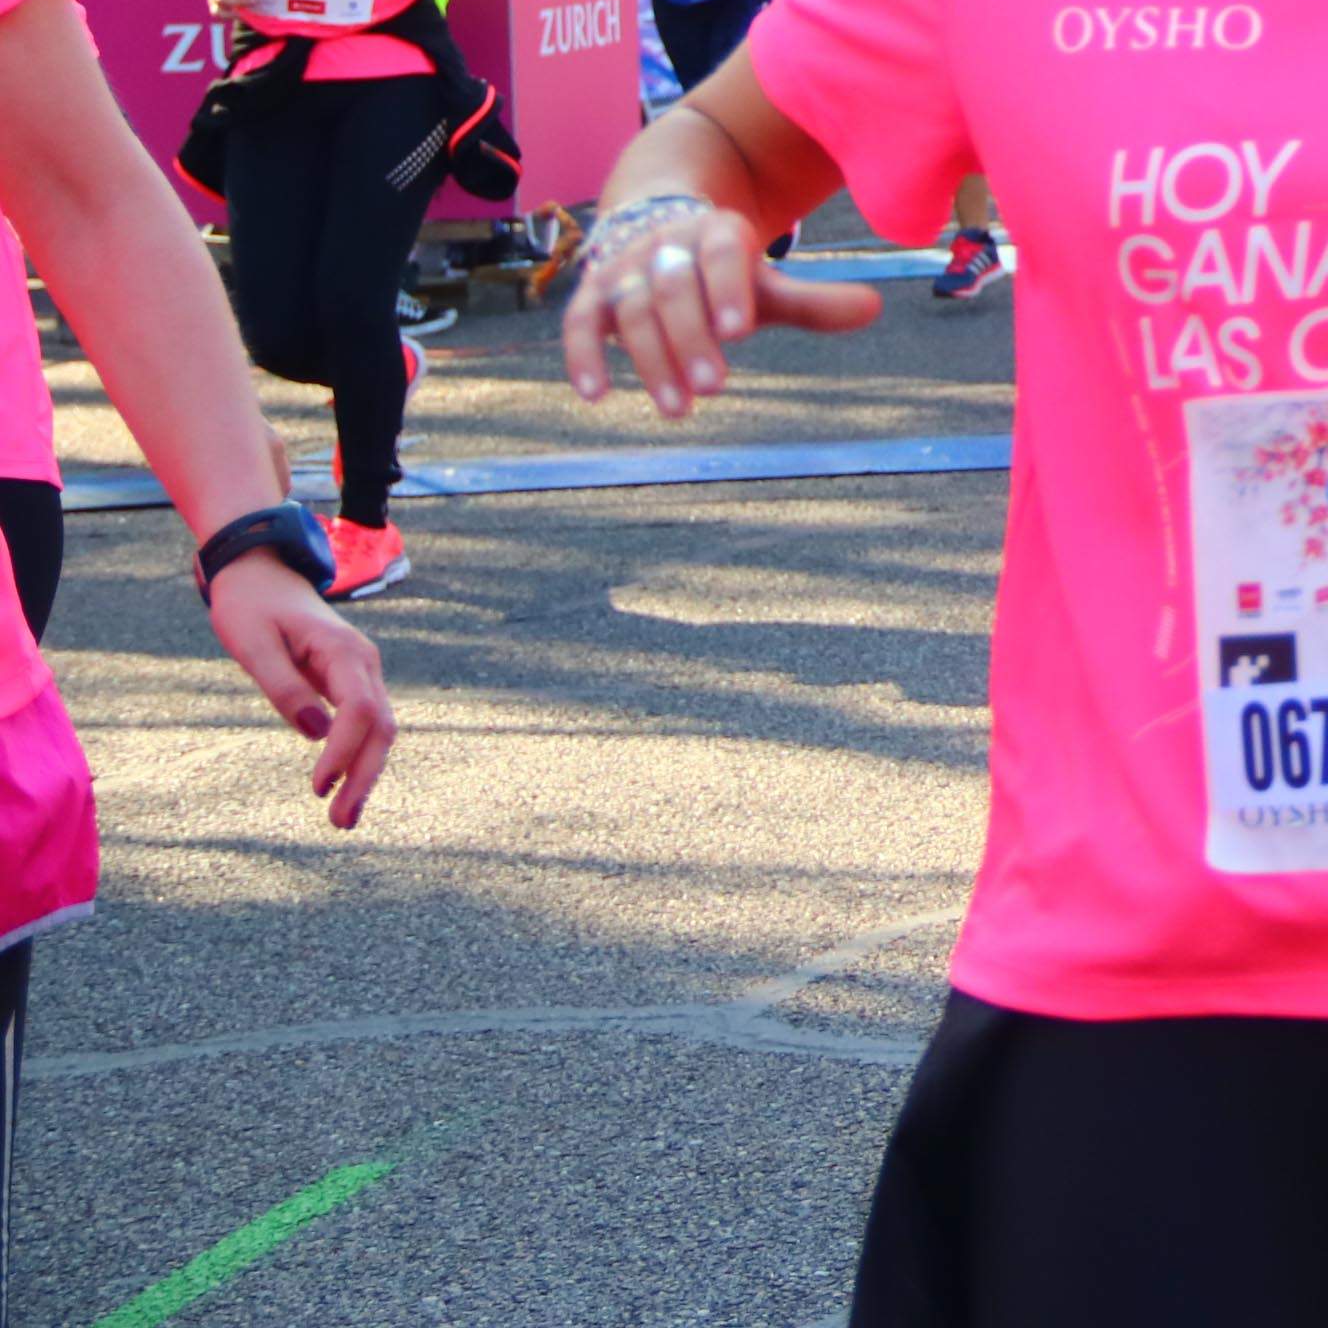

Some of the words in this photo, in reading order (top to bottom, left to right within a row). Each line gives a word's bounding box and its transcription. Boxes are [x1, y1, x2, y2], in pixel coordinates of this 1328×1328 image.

[1052, 4, 1263, 54] OYSHO
[1108, 138, 1302, 229] HOY
[1139, 315, 1263, 392] LAS
